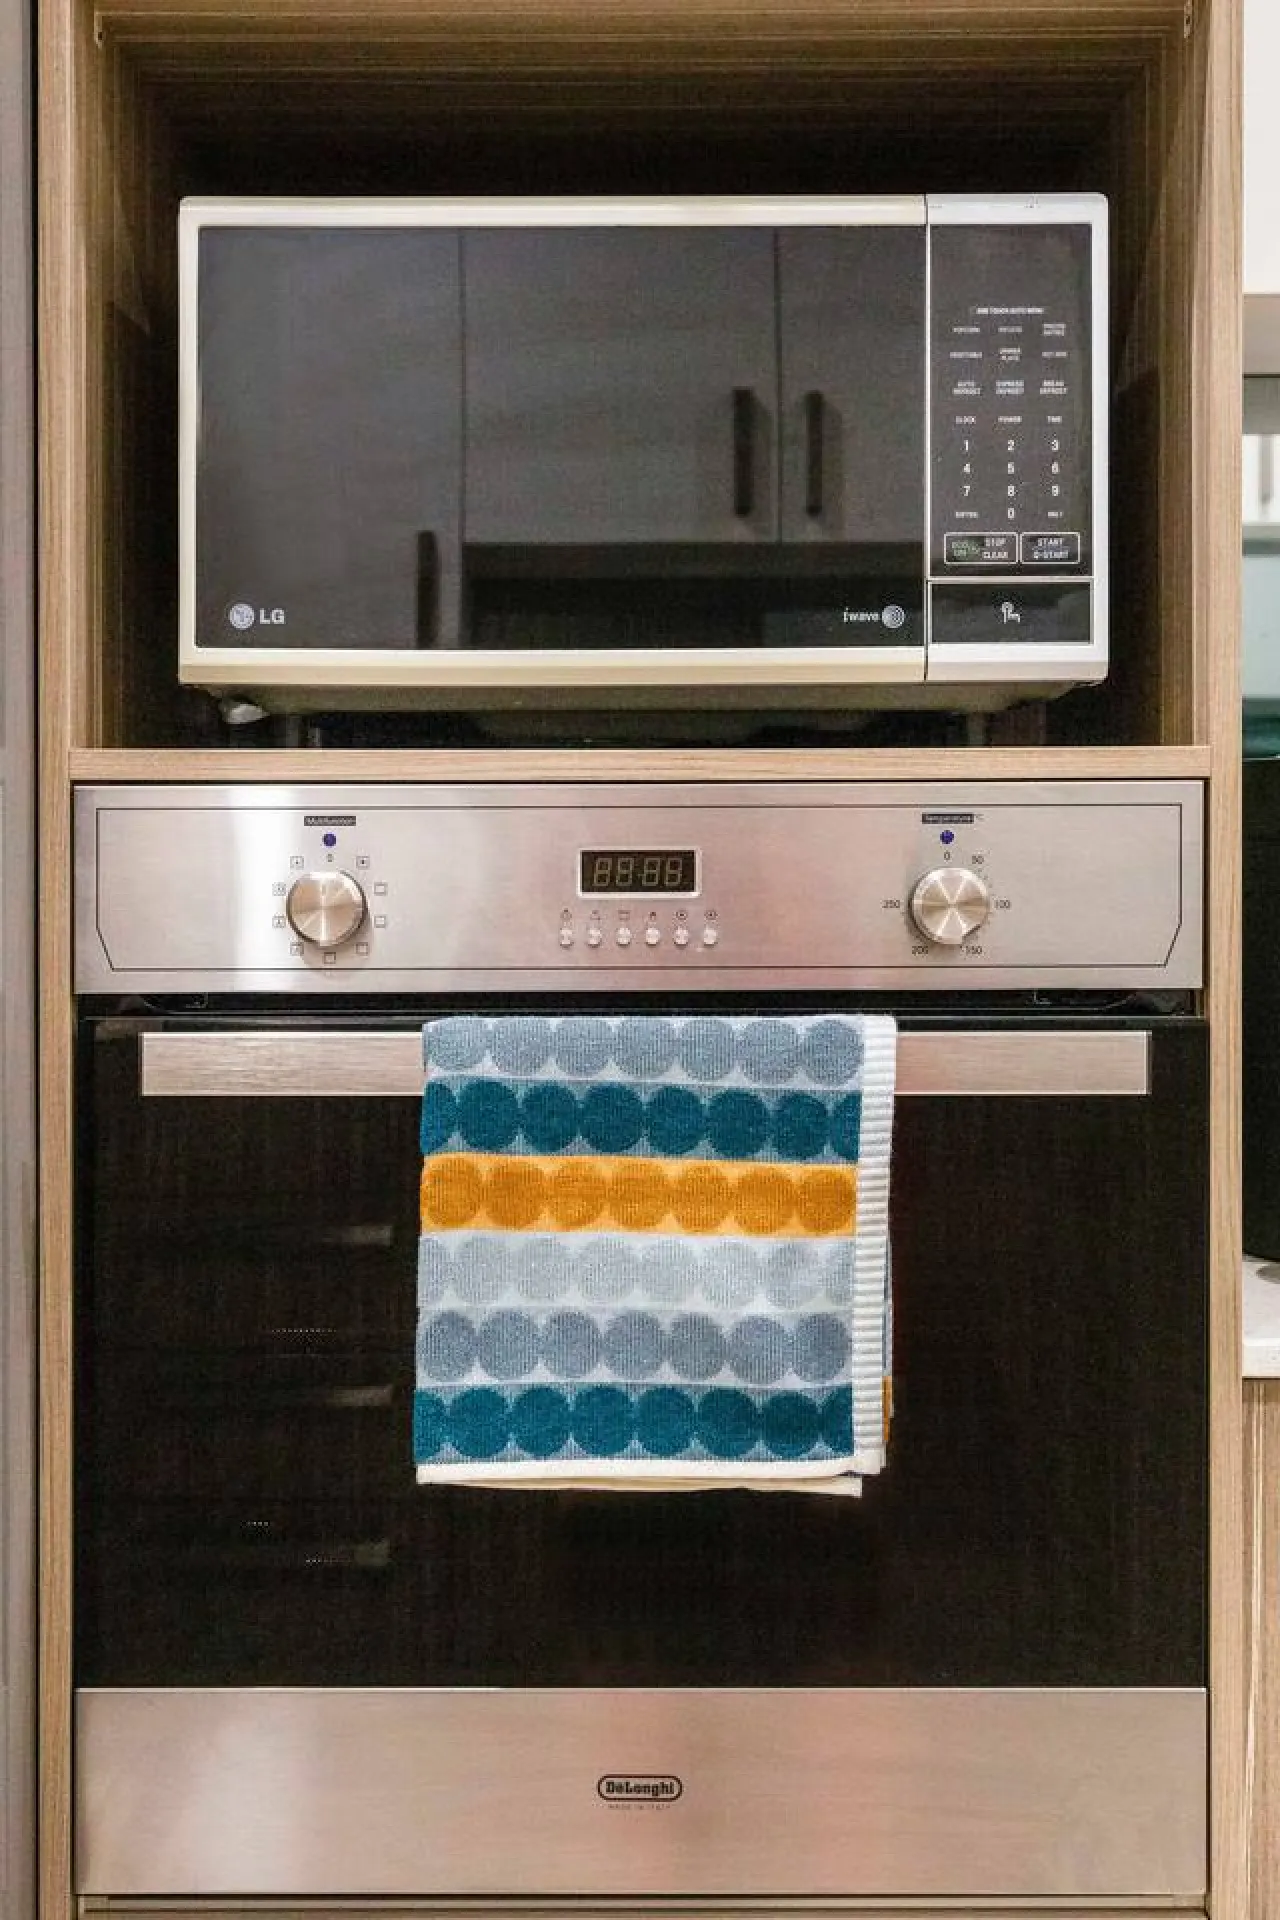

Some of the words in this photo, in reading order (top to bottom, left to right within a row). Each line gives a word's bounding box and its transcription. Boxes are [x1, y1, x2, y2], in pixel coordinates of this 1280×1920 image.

[963, 439, 969, 452] 1
[1007, 439, 1015, 452] 2
[1051, 439, 1059, 452] 3
[963, 462, 971, 474] 4
[1007, 462, 1015, 475] 5
[1051, 462, 1060, 475] 6
[963, 485, 971, 497] 7
[1007, 485, 1015, 497] 8
[1051, 485, 1059, 497] 9
[1007, 507, 1015, 519] 0
[1037, 537, 1064, 547] START
[982, 551, 1009, 559] CLEAR
[259, 607, 285, 625] LG
[943, 851, 951, 861] 0
[971, 855, 985, 865] 50
[882, 899, 900, 909] 250
[995, 899, 1011, 910] 100
[605, 1781, 675, 1797] DeLonghi
